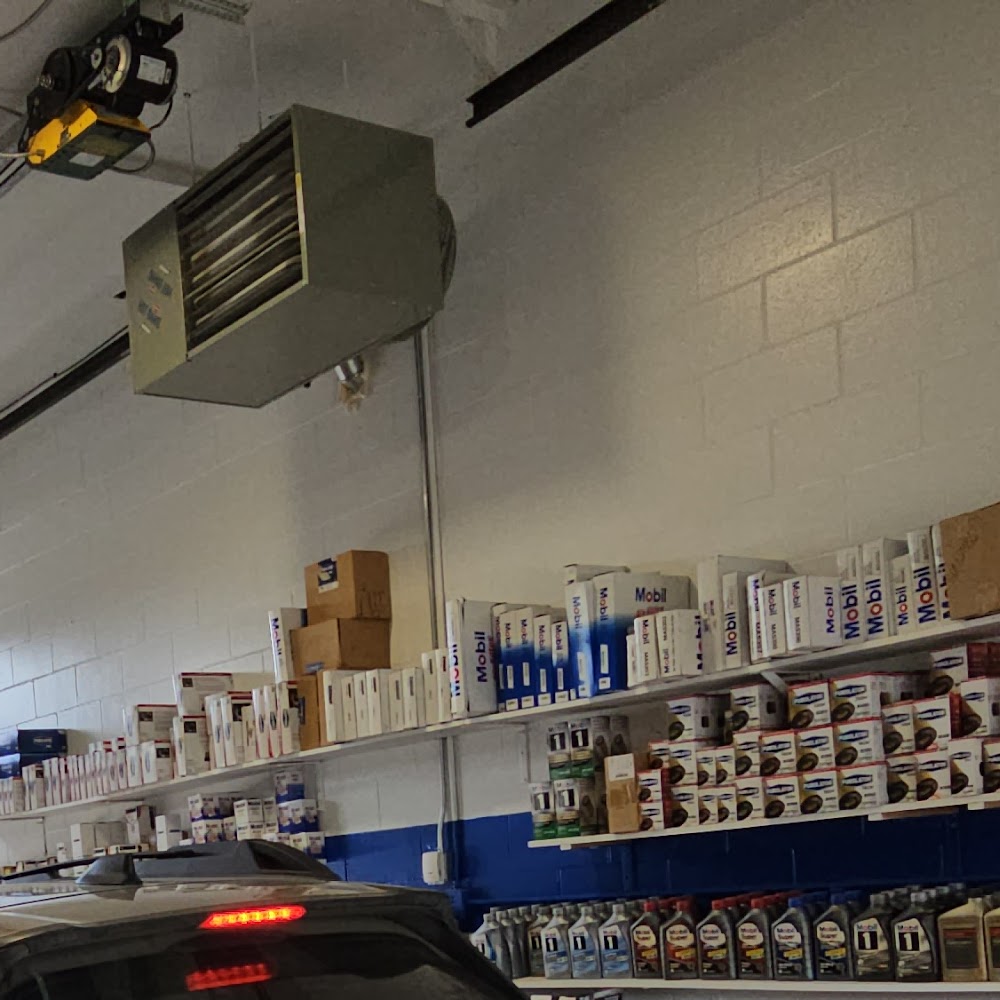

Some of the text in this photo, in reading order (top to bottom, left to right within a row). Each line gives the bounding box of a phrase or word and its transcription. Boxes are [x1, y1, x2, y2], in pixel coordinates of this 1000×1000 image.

[600, 587, 608, 621] Mobil
[635, 587, 667, 603] Mobil
[768, 589, 777, 616] Mobil
[792, 581, 802, 609] Mobil
[824, 586, 836, 634] Mobil
[865, 578, 884, 635] Mobil
[896, 586, 908, 626] Mobil
[913, 566, 937, 624] Mobil
[572, 596, 583, 630] Mobil
[842, 584, 860, 640] Mobil
[642, 619, 650, 645] Mobil
[725, 611, 738, 657] Mobil
[474, 631, 488, 683] Mobil
[576, 936, 582, 950] 1
[606, 936, 614, 950] 1
[862, 932, 871, 950] 1
[897, 924, 918, 932] Mobil
[904, 932, 912, 950] 1
